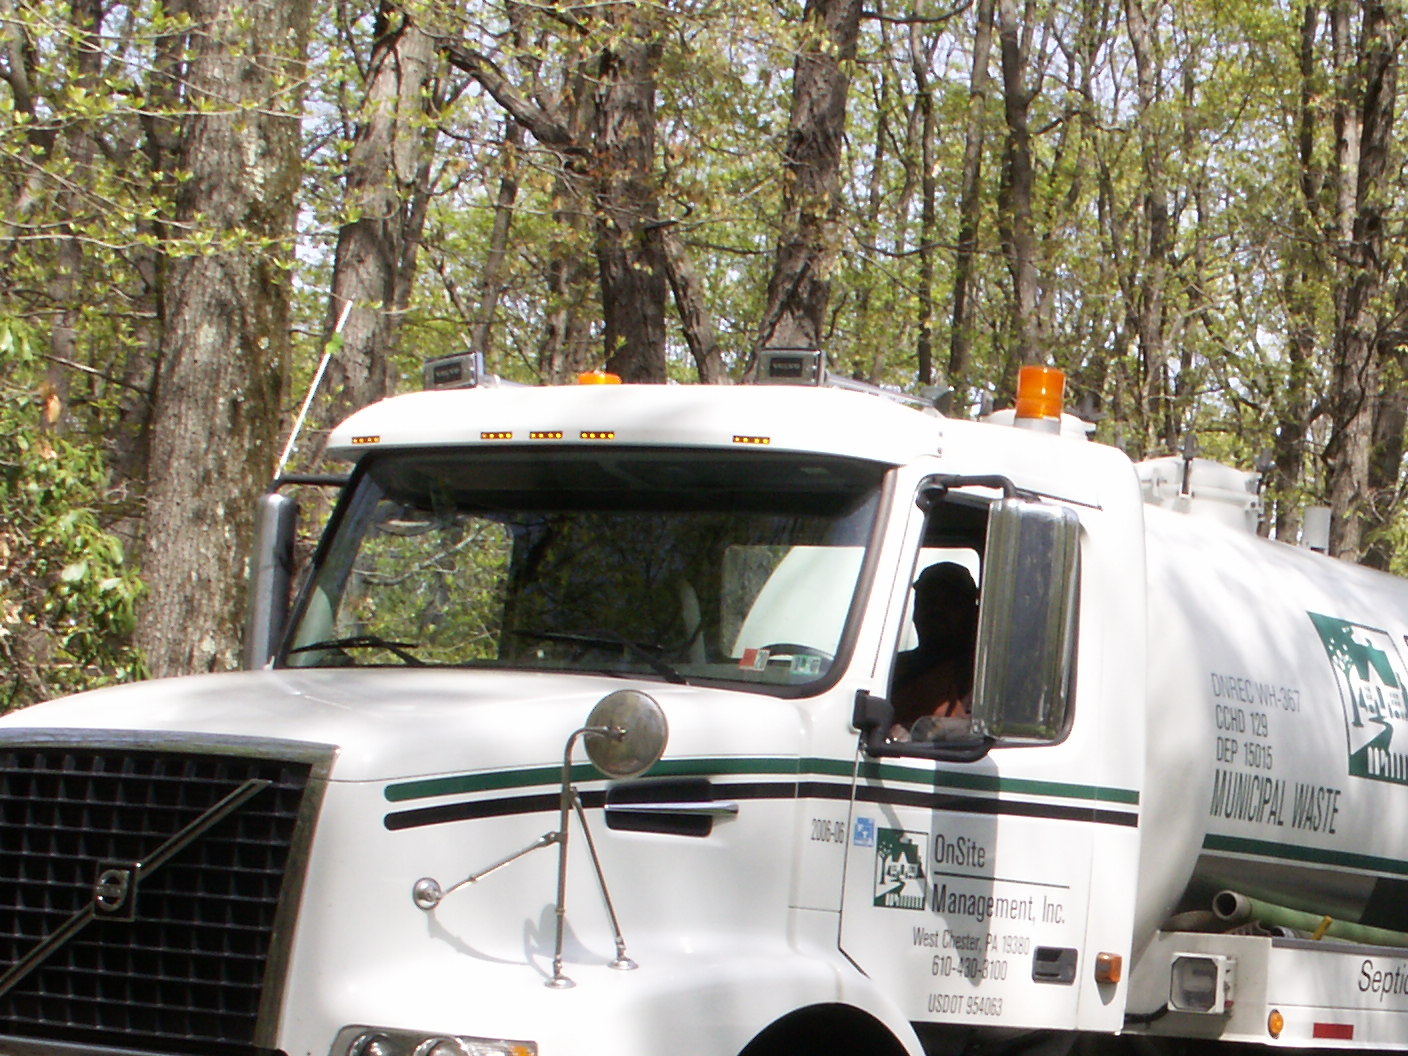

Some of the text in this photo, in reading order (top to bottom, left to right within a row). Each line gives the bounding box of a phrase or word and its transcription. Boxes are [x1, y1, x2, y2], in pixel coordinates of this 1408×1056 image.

[1215, 704, 1269, 738] CCHD 129
[1216, 736, 1273, 770] DEP 15015
[1210, 768, 1341, 834] MUNICIPAL WASTE
[934, 833, 986, 869] OnSite
[931, 883, 1066, 926] Management, Inc.
[912, 926, 939, 948] West
[986, 932, 998, 953] PA
[932, 954, 1008, 981] 610-430-3100
[928, 993, 964, 1014] USDOT
